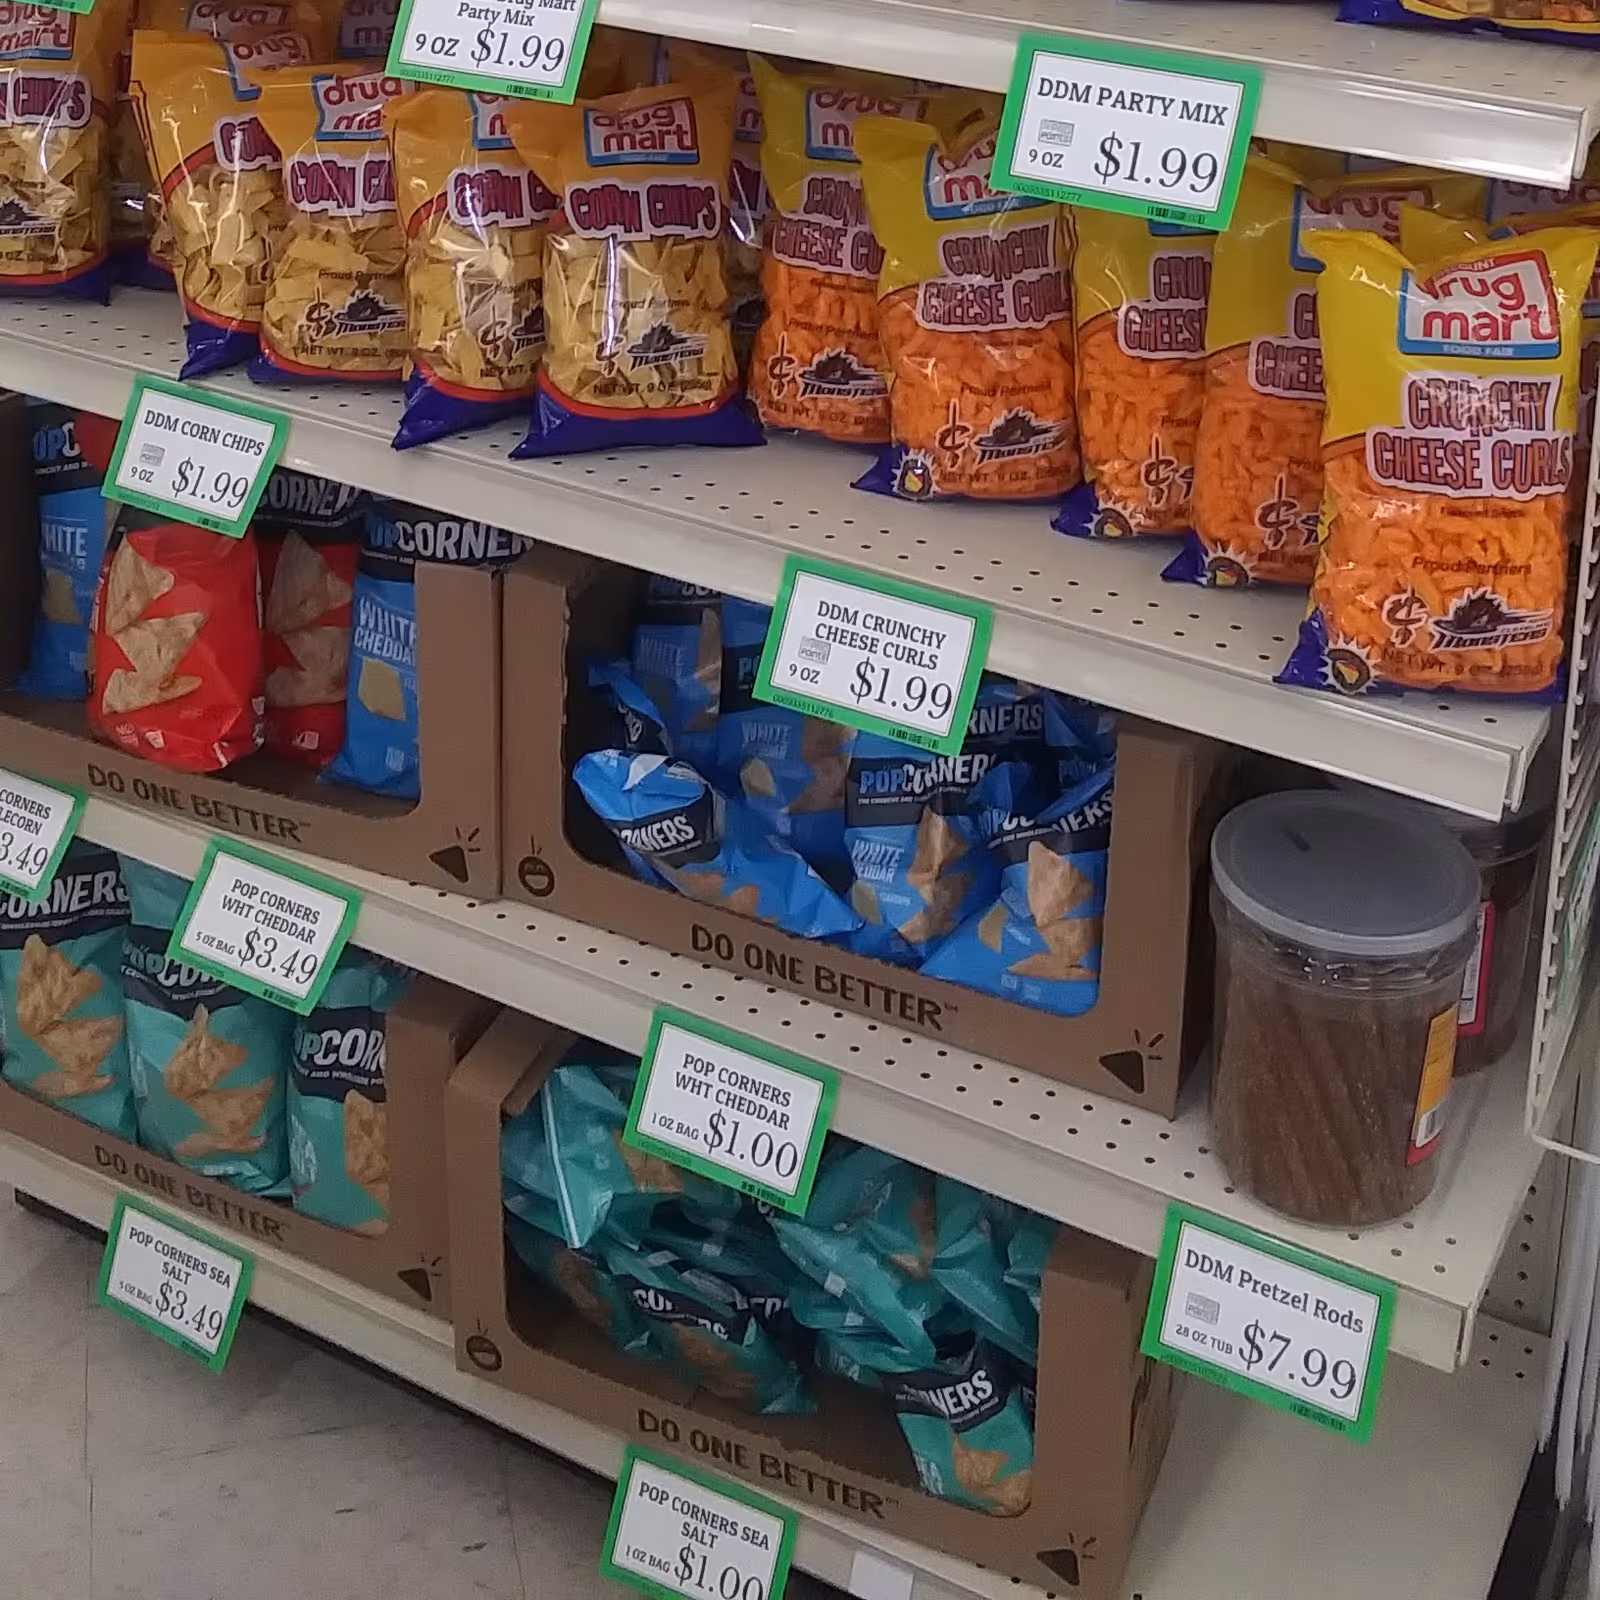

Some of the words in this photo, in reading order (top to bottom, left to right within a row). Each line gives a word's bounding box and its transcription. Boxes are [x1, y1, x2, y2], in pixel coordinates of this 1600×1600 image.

[457, 2, 502, 26] Party
[503, 8, 535, 28] Mix
[415, 33, 427, 53] 9
[430, 35, 460, 57] OZ
[470, 21, 566, 73] $1.99
[13, 75, 88, 125] CHIPS
[1036, 76, 1093, 105] DDM
[1095, 86, 1176, 118] PARTY
[1178, 99, 1229, 127] MIX
[603, 122, 698, 153] mart
[1028, 148, 1038, 164] 9
[1041, 151, 1065, 169] OZ
[1093, 130, 1219, 194] $1.99
[290, 157, 357, 210] CORN
[569, 183, 643, 234] CORN
[646, 183, 717, 231] CHIPS
[943, 224, 1052, 282] CRUNCHY
[921, 280, 1006, 326] CHEESE
[1422, 304, 1559, 342] mart
[1408, 377, 1551, 438] CRUNCHY
[143, 409, 180, 433] DDM
[181, 420, 221, 444] CORN
[222, 431, 266, 457] CHIPS
[130, 466, 138, 478] 9
[138, 468, 154, 484] OZ
[171, 456, 250, 509] $1.99
[1373, 432, 1483, 490] CHEESE
[1492, 436, 1572, 493] CURLS
[1412, 555, 1463, 573] Proud
[1466, 558, 1533, 577] Partners
[815, 622, 880, 655] CHEESE
[882, 640, 939, 671] CURLS
[817, 600, 860, 626] DDM
[862, 613, 947, 650] CRUNCHY
[789, 663, 798, 677] 9
[800, 666, 821, 685] OZ
[849, 656, 952, 720] $1.99
[0, 788, 52, 820] CORNERS
[87, 762, 126, 794] DO
[132, 774, 188, 811] ONE
[852, 839, 904, 864] WHITE
[221, 893, 253, 922] WHT
[253, 908, 317, 947] CHEDDAR
[231, 877, 259, 901] POP
[260, 889, 321, 926] CORNERS
[196, 930, 203, 943] 5
[203, 933, 216, 949] OZ
[215, 937, 237, 957] BAG
[237, 926, 320, 986] $3.49
[690, 922, 735, 962] DO
[743, 941, 804, 986] ONE
[674, 1070, 714, 1100] WHT
[714, 1087, 791, 1132] CHEDDAR
[682, 1052, 716, 1078] POP
[717, 1066, 792, 1108] CORNERS
[651, 1112, 657, 1124] 1
[658, 1114, 674, 1131] OZ
[675, 1123, 700, 1142] BAG
[702, 1108, 799, 1178] $1.00
[93, 1143, 128, 1175] DO
[133, 1161, 178, 1197] ONE
[129, 1226, 154, 1248] POP
[154, 1240, 208, 1276] CORNERS
[209, 1266, 231, 1289] SEA
[162, 1261, 192, 1286] SALT
[124, 1284, 137, 1296] OZ
[136, 1288, 153, 1305] BAG
[155, 1279, 224, 1341] $3.49
[1184, 1248, 1235, 1284] DDM
[1237, 1269, 1309, 1313] Pretzel
[1312, 1298, 1365, 1335] Rods
[1175, 1323, 1190, 1338] 28
[1191, 1329, 1207, 1345] OZ
[1209, 1336, 1233, 1355] TUB
[1238, 1318, 1357, 1399] $7.99
[637, 1407, 681, 1444] DO
[689, 1428, 750, 1471] ONE
[638, 1481, 670, 1506] POP
[671, 1495, 739, 1537] CORNERS
[740, 1524, 770, 1551] SEA
[680, 1521, 719, 1549] SALT
[625, 1545, 631, 1557] 1
[632, 1547, 648, 1563] OZ
[648, 1554, 671, 1573] BAG
[673, 1542, 765, 1600] $1.00
